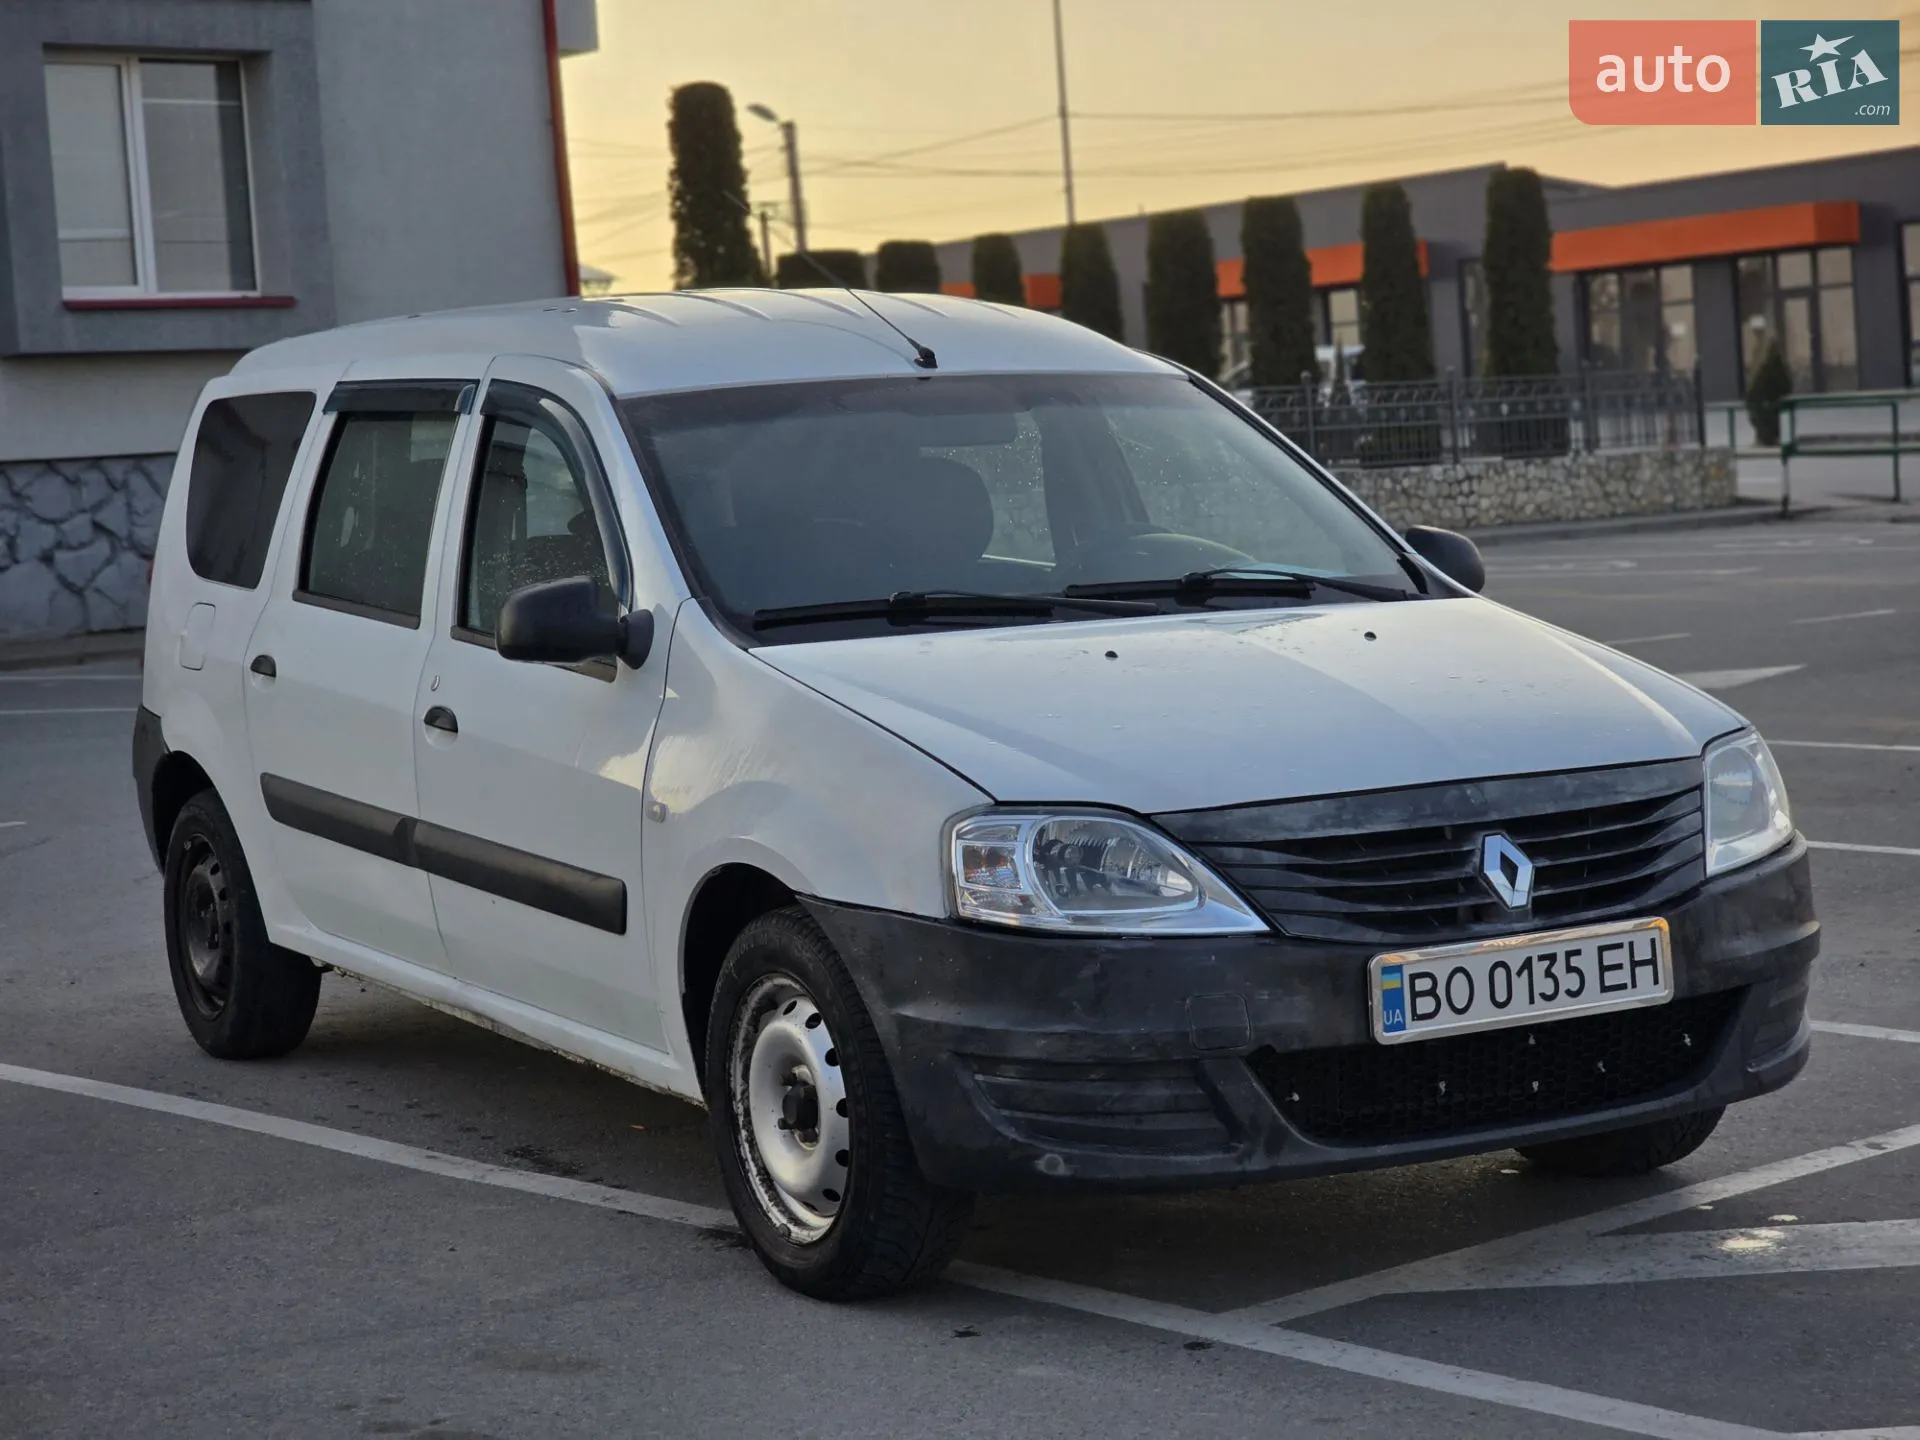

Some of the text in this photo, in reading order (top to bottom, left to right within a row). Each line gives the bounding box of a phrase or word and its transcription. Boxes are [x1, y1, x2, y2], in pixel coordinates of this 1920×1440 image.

[1408, 937, 1660, 1022] BO 0135 EH
[1383, 1009, 1404, 1026] UA
